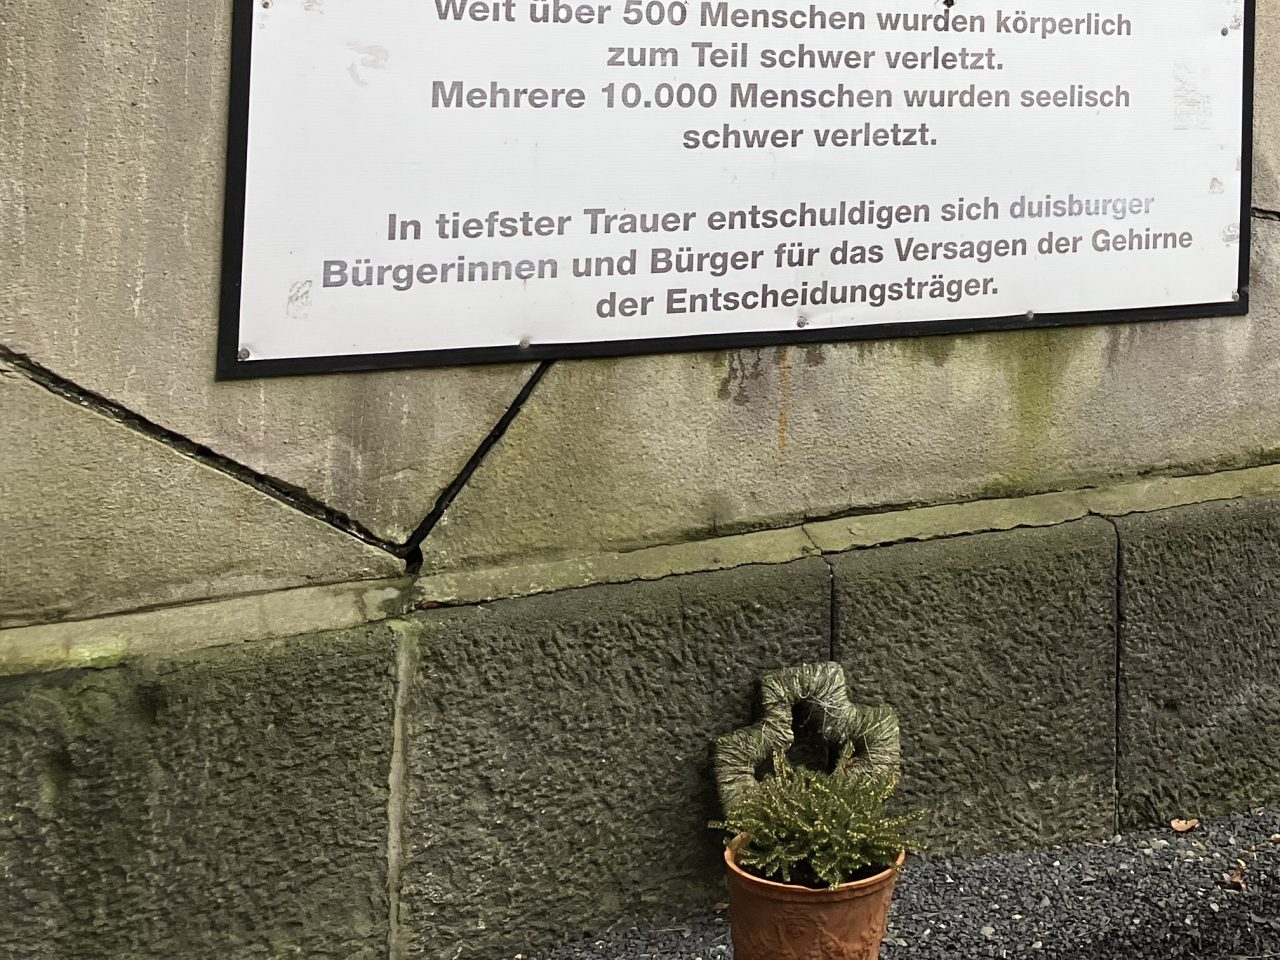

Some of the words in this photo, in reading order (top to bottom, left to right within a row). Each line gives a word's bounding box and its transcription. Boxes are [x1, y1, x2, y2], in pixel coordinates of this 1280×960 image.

[623, 1, 687, 26] 500
[701, 2, 865, 29] Menschen
[876, 9, 984, 32] wurden
[997, 10, 1131, 39] körperlich
[607, 47, 678, 66] zum
[691, 42, 747, 67] Teil
[760, 44, 875, 69] schwer
[885, 46, 1003, 70] verletzt.
[432, 81, 585, 108] Mehrere
[602, 83, 717, 108] 10.000
[730, 83, 892, 108] Menschen
[904, 84, 1009, 107] wurden
[1021, 85, 1129, 107] seelisch
[683, 124, 803, 149] schwer
[814, 122, 936, 147] verletzt.
[388, 214, 421, 240] In
[436, 211, 571, 239] tiefster
[584, 208, 696, 234] Trauer
[708, 200, 929, 230] entschuldigen
[941, 197, 998, 221] sich
[1010, 194, 1154, 220] duisburger
[323, 256, 557, 291] Bürgerinnen
[573, 249, 636, 277] und
[651, 247, 764, 277] Bürger
[774, 242, 820, 268] für
[830, 240, 883, 265] das
[894, 237, 1026, 263] Versagen
[1038, 232, 1082, 254] der
[1092, 228, 1192, 252] Gehirne
[596, 292, 654, 318] der
[666, 274, 997, 315] Entscheidungsträger.
